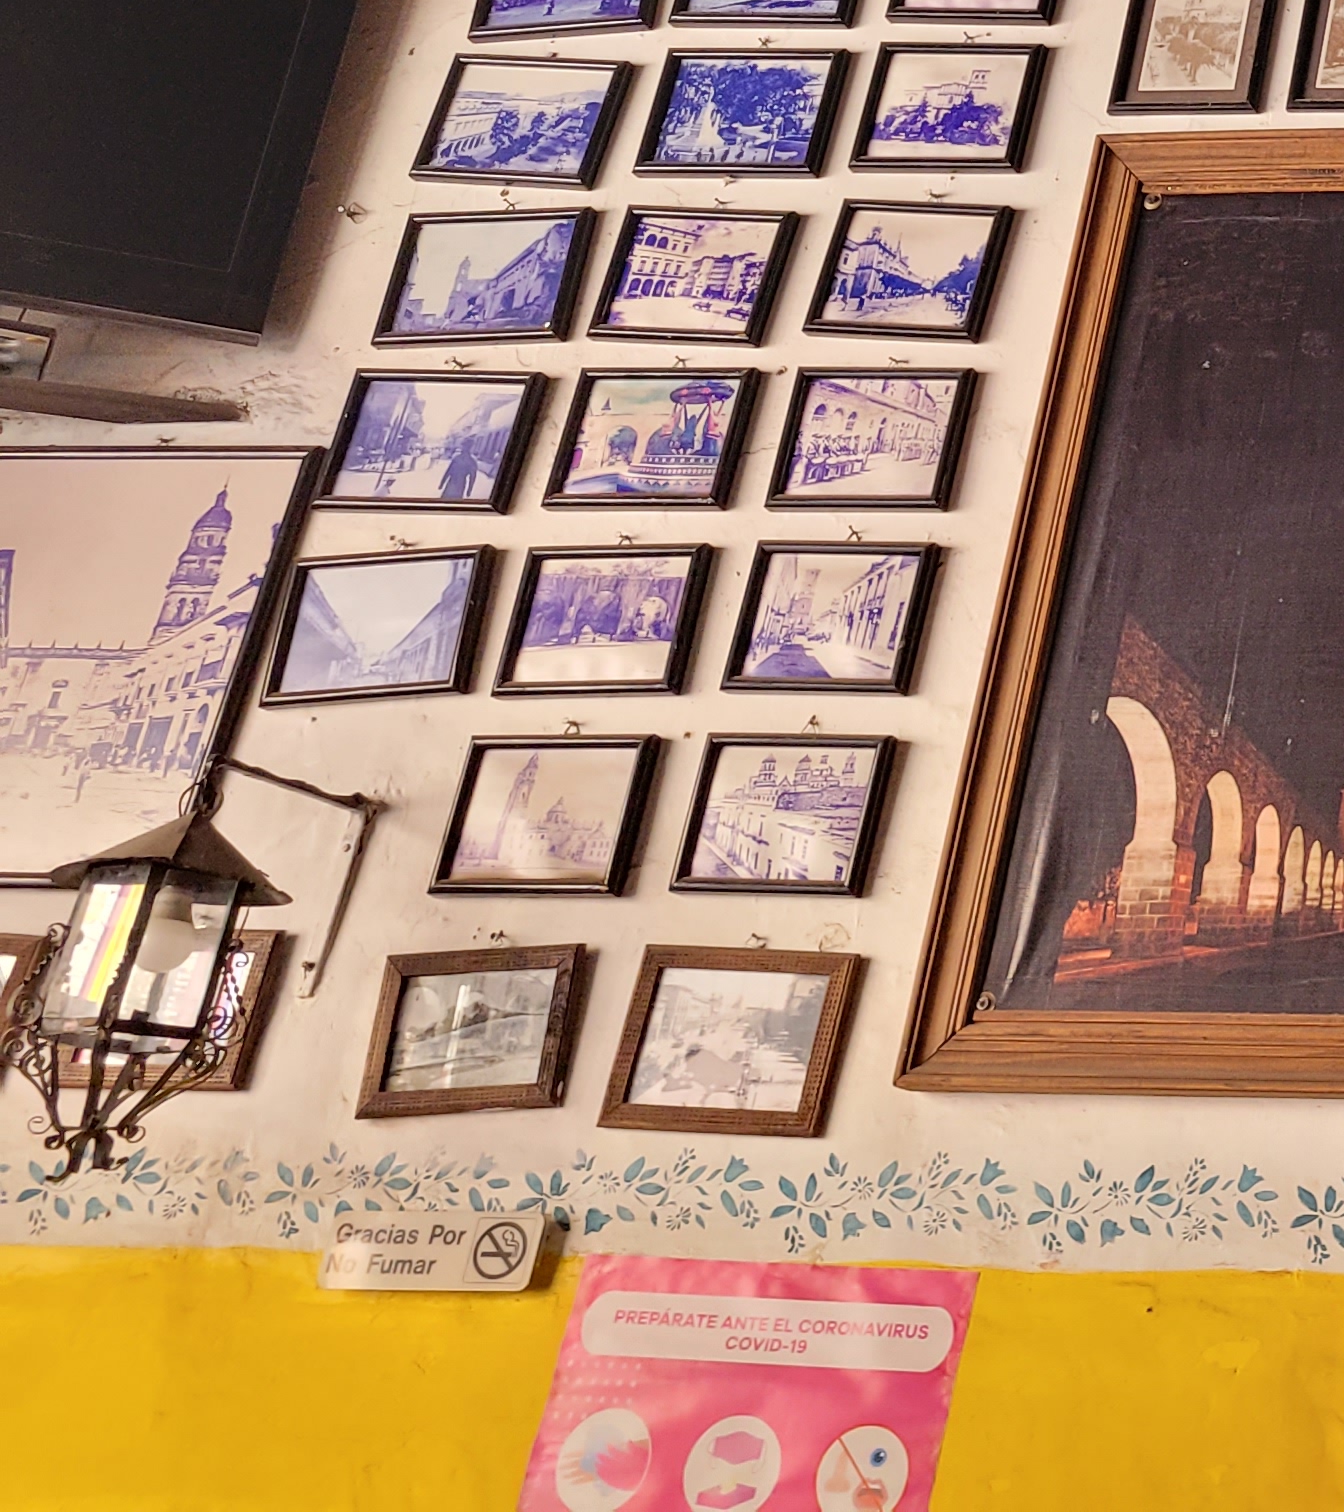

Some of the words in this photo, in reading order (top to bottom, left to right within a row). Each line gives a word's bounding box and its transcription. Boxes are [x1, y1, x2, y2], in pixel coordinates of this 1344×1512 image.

[336, 1223, 419, 1245] Gracias
[428, 1224, 467, 1245] Por
[326, 1254, 356, 1273] No
[367, 1254, 437, 1275] Fumar
[613, 1307, 718, 1329] PREPÁRATE
[721, 1315, 769, 1332] ANTE
[773, 1318, 793, 1333] EL
[799, 1319, 930, 1340] CORONAVIRUS
[725, 1336, 808, 1354] COVID-19
